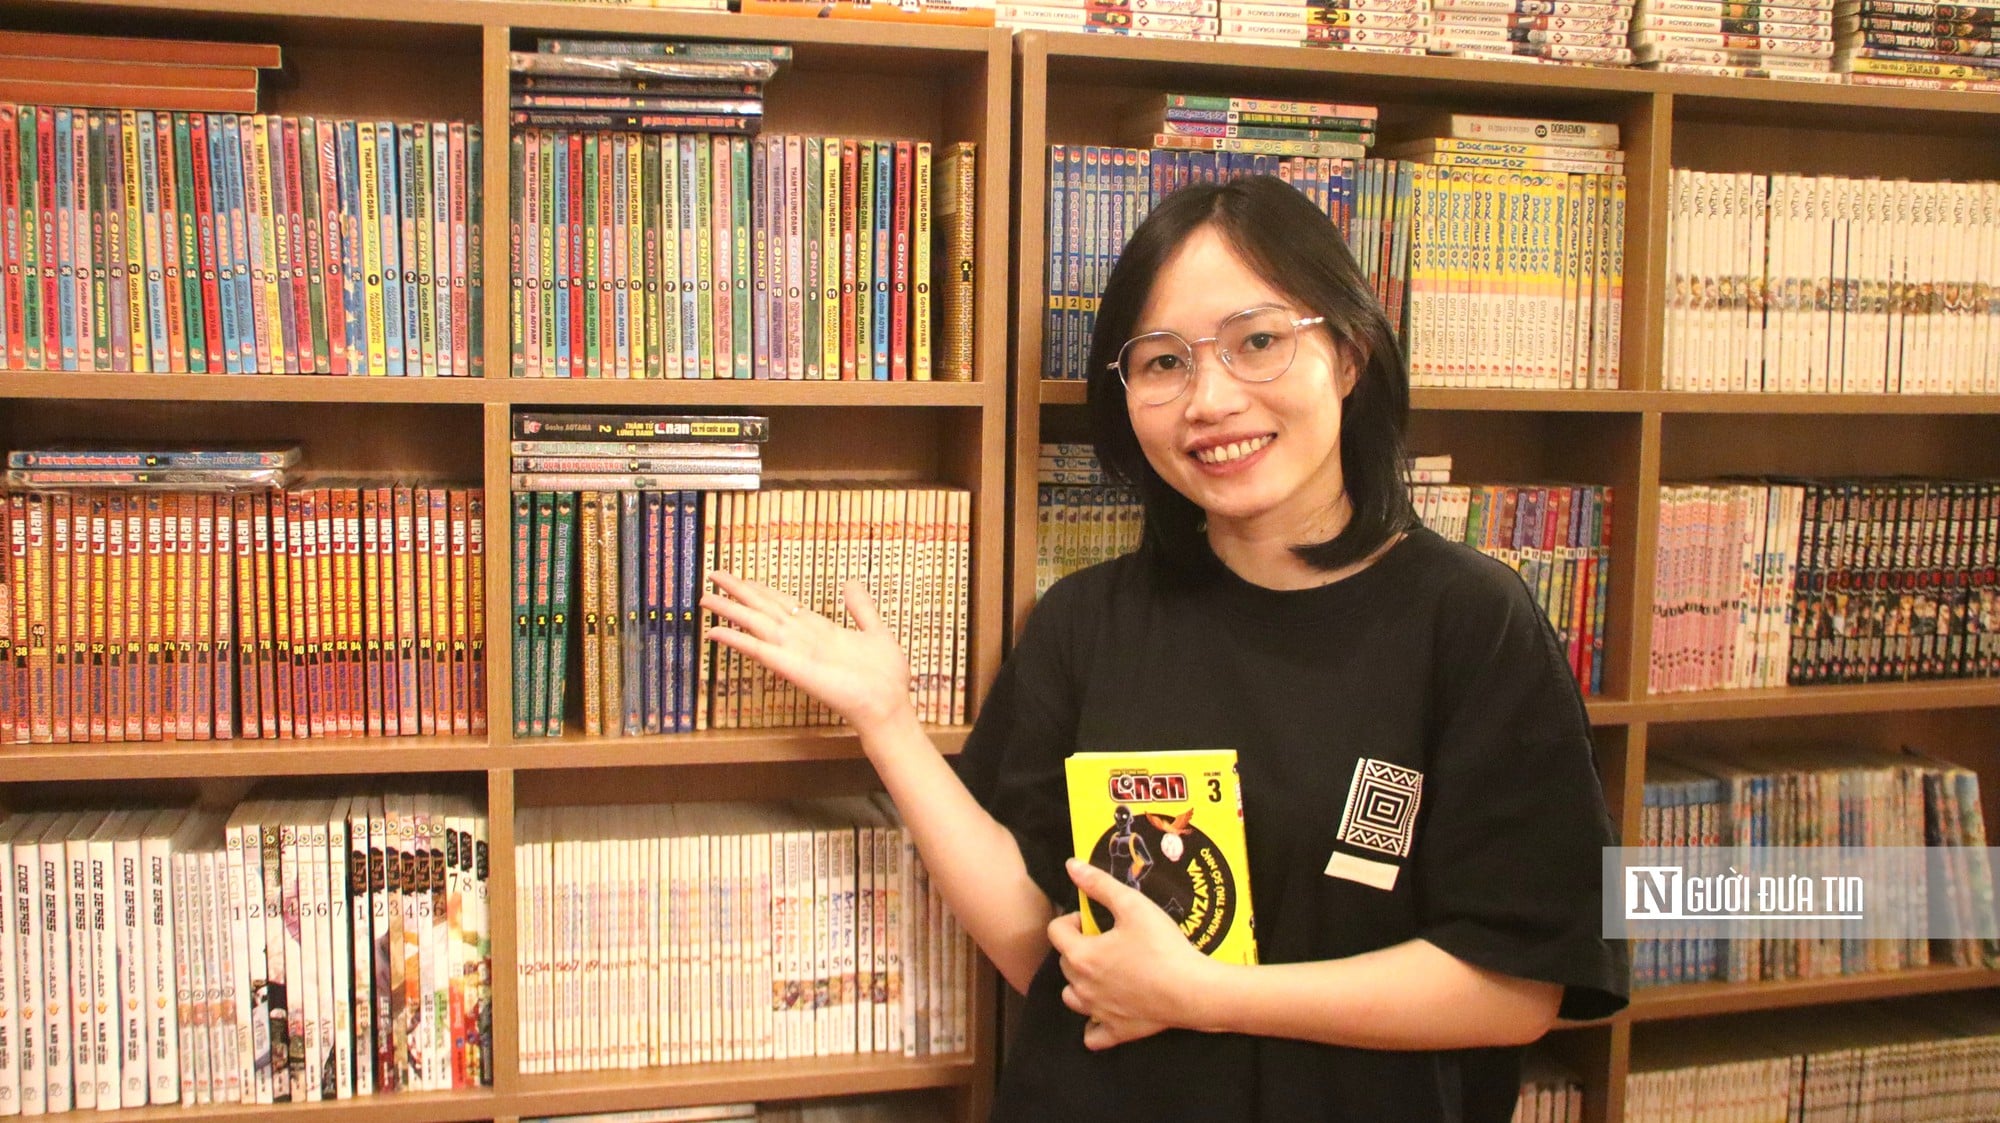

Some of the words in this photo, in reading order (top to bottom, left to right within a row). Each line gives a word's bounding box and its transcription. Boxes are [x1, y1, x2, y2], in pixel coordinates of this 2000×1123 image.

[1551, 123, 1586, 134] DORAEMON
[111, 212, 121, 263] CONAN
[599, 424, 611, 433] 2
[1208, 779, 1222, 802] 3
[45, 861, 55, 891] CODE
[74, 860, 85, 890] CODE
[93, 860, 104, 890] CODE
[124, 857, 134, 887] CODE
[152, 856, 163, 886] CODE
[18, 864, 29, 895] CODE
[449, 873, 458, 892] 7
[463, 877, 472, 892] 8
[478, 887, 488, 899] 9
[233, 907, 240, 921] 1
[249, 904, 260, 918] 2
[302, 903, 312, 917] 5
[317, 902, 327, 916] 6
[333, 901, 343, 917] 7
[358, 904, 364, 920] 1
[374, 902, 384, 917] 2
[405, 904, 414, 919] 4
[419, 902, 430, 917] 5
